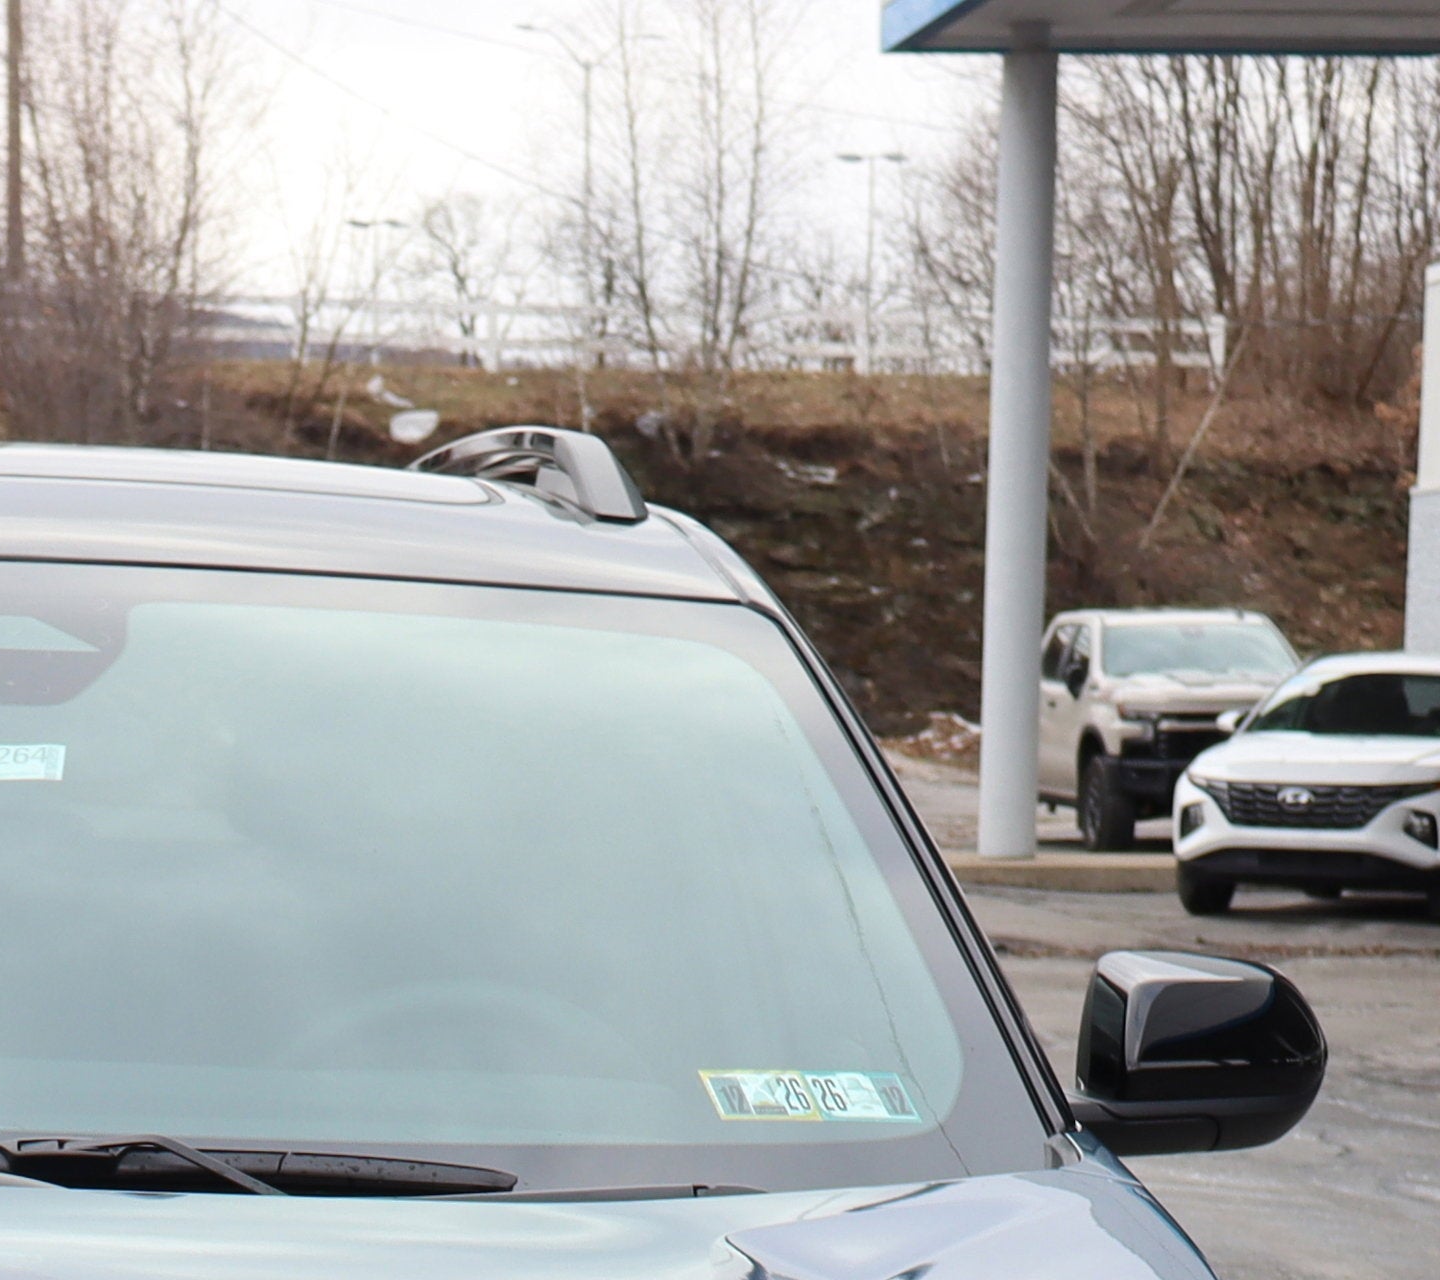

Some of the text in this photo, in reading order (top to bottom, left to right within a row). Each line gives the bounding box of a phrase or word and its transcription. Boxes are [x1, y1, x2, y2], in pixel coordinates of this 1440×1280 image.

[776, 1077, 811, 1111] 26
[812, 1078, 913, 1115] 26 12
